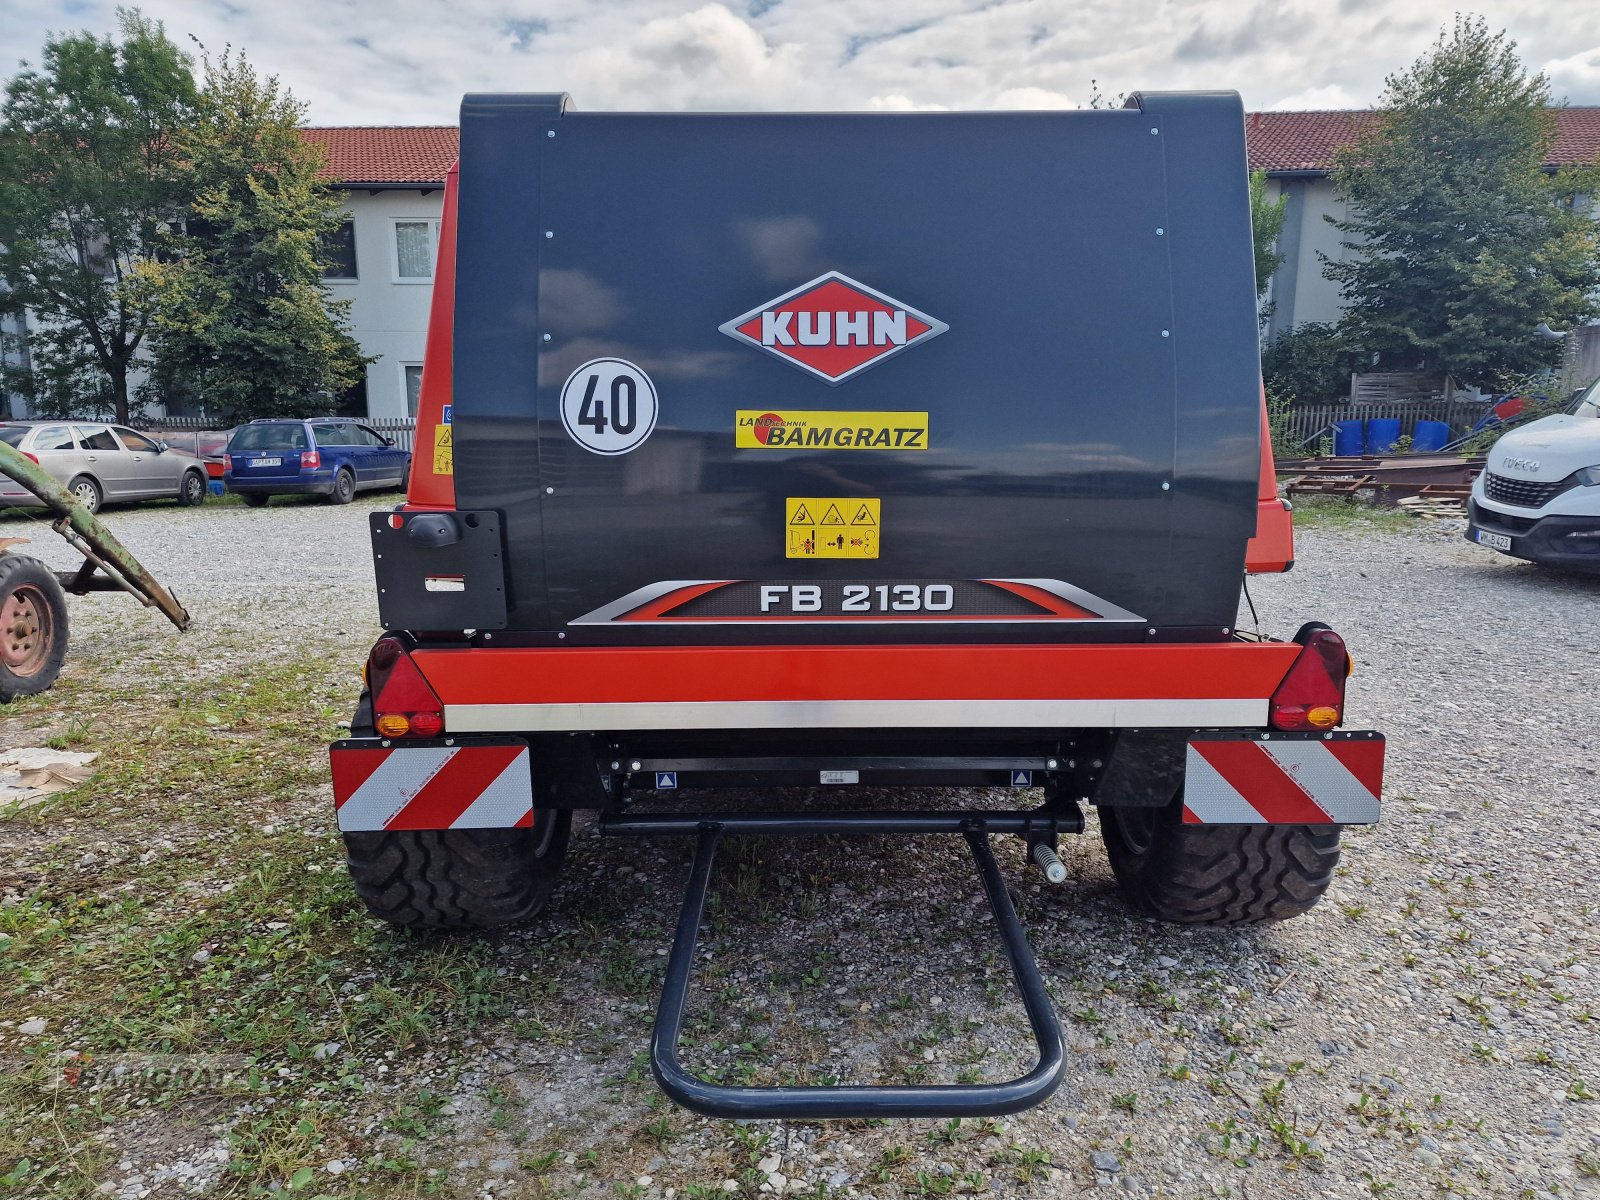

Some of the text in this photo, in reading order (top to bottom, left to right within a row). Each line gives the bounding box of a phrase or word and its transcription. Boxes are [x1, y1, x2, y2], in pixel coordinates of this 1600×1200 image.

[762, 310, 907, 346] KUHN
[578, 374, 637, 435] 40
[766, 427, 925, 447] BAMGRATZ
[1502, 456, 1540, 473] IVECO
[761, 584, 954, 612] FB 2130
